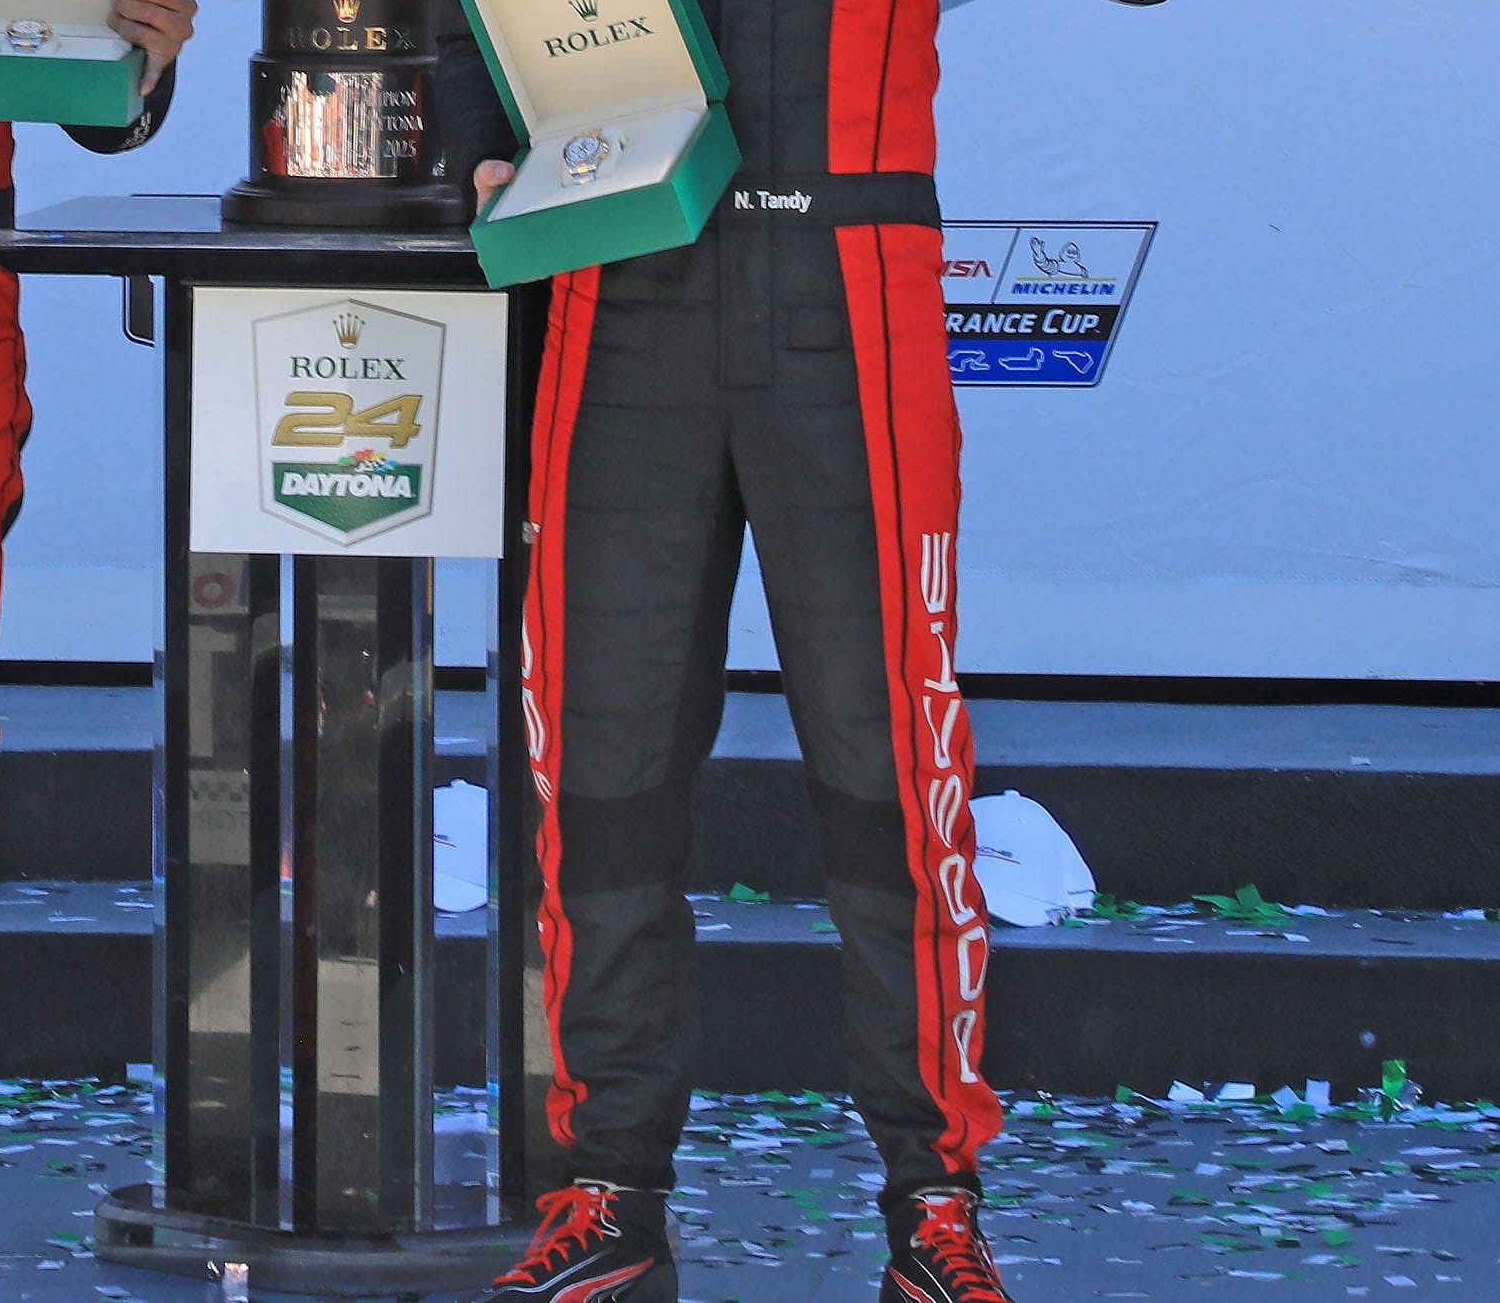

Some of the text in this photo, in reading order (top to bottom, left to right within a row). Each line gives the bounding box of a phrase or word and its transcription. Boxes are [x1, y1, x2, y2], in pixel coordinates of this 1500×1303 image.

[540, 16, 657, 59] ROLEX
[734, 189, 814, 215] N. Tandy
[1011, 281, 1116, 297] MICHELIN
[942, 307, 1101, 335] RANCE CUP
[288, 354, 408, 382] ROLEX
[270, 390, 424, 449] 24
[280, 470, 414, 499] DAYTONA
